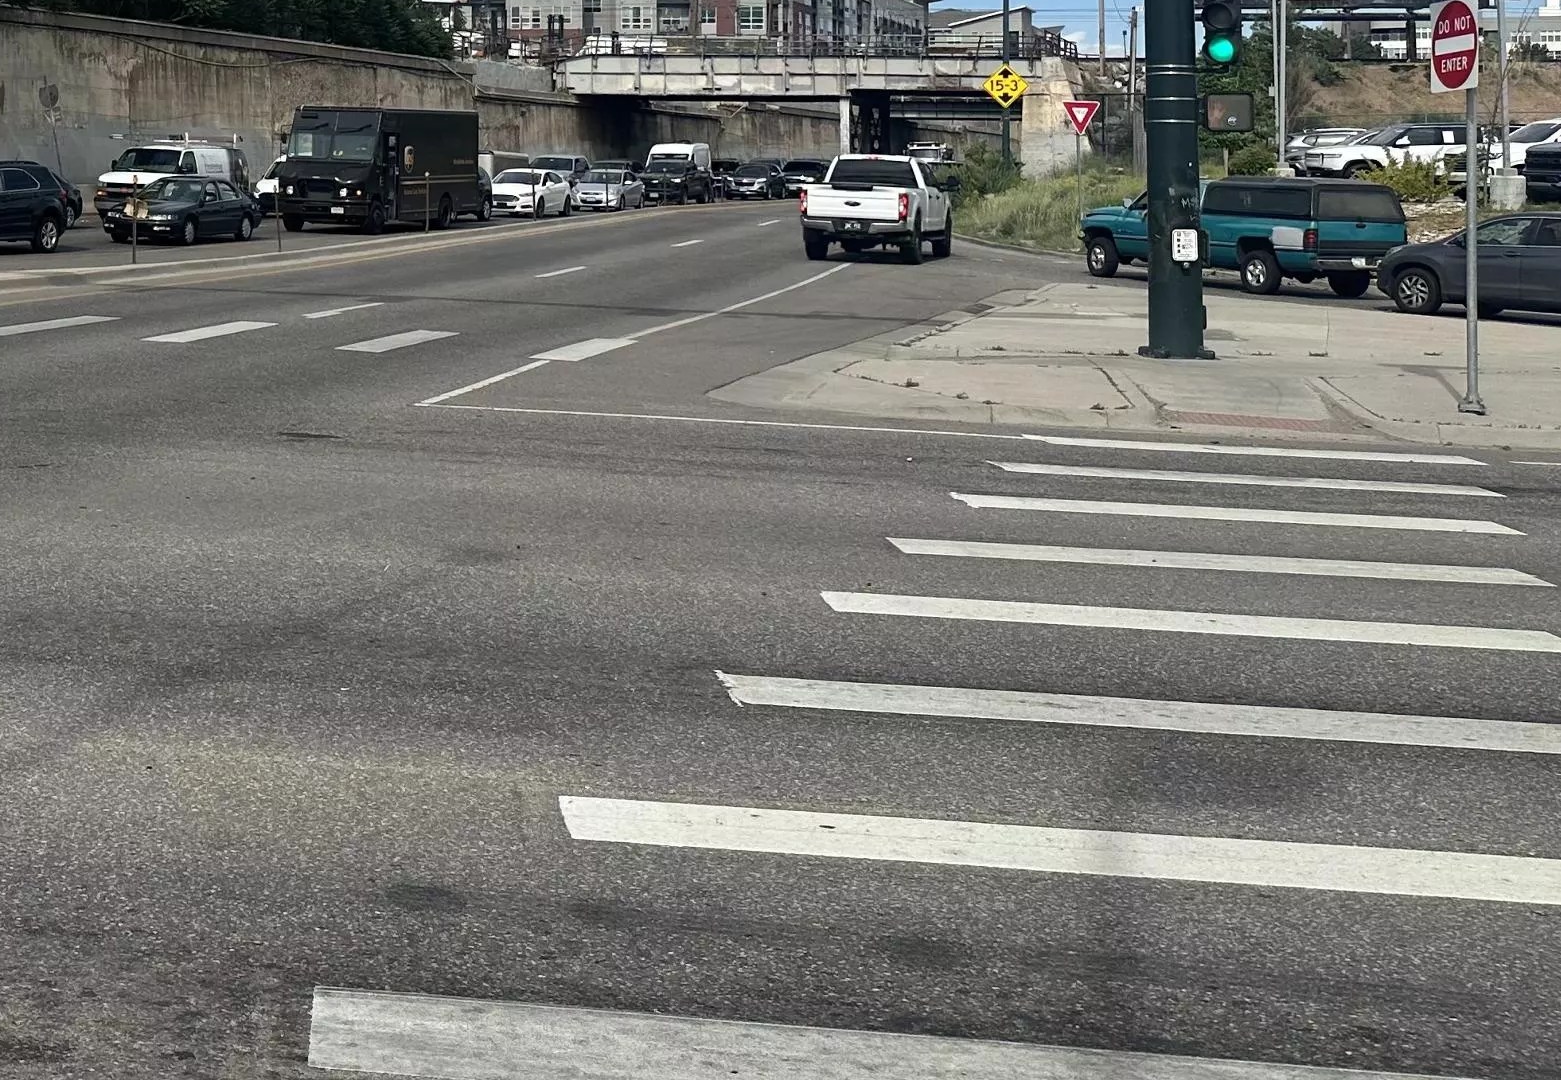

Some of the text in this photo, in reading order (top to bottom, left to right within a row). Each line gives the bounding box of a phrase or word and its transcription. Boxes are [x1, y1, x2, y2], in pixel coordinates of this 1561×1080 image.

[1438, 15, 1472, 35] DO NOT
[1441, 56, 1468, 74] ENTER
